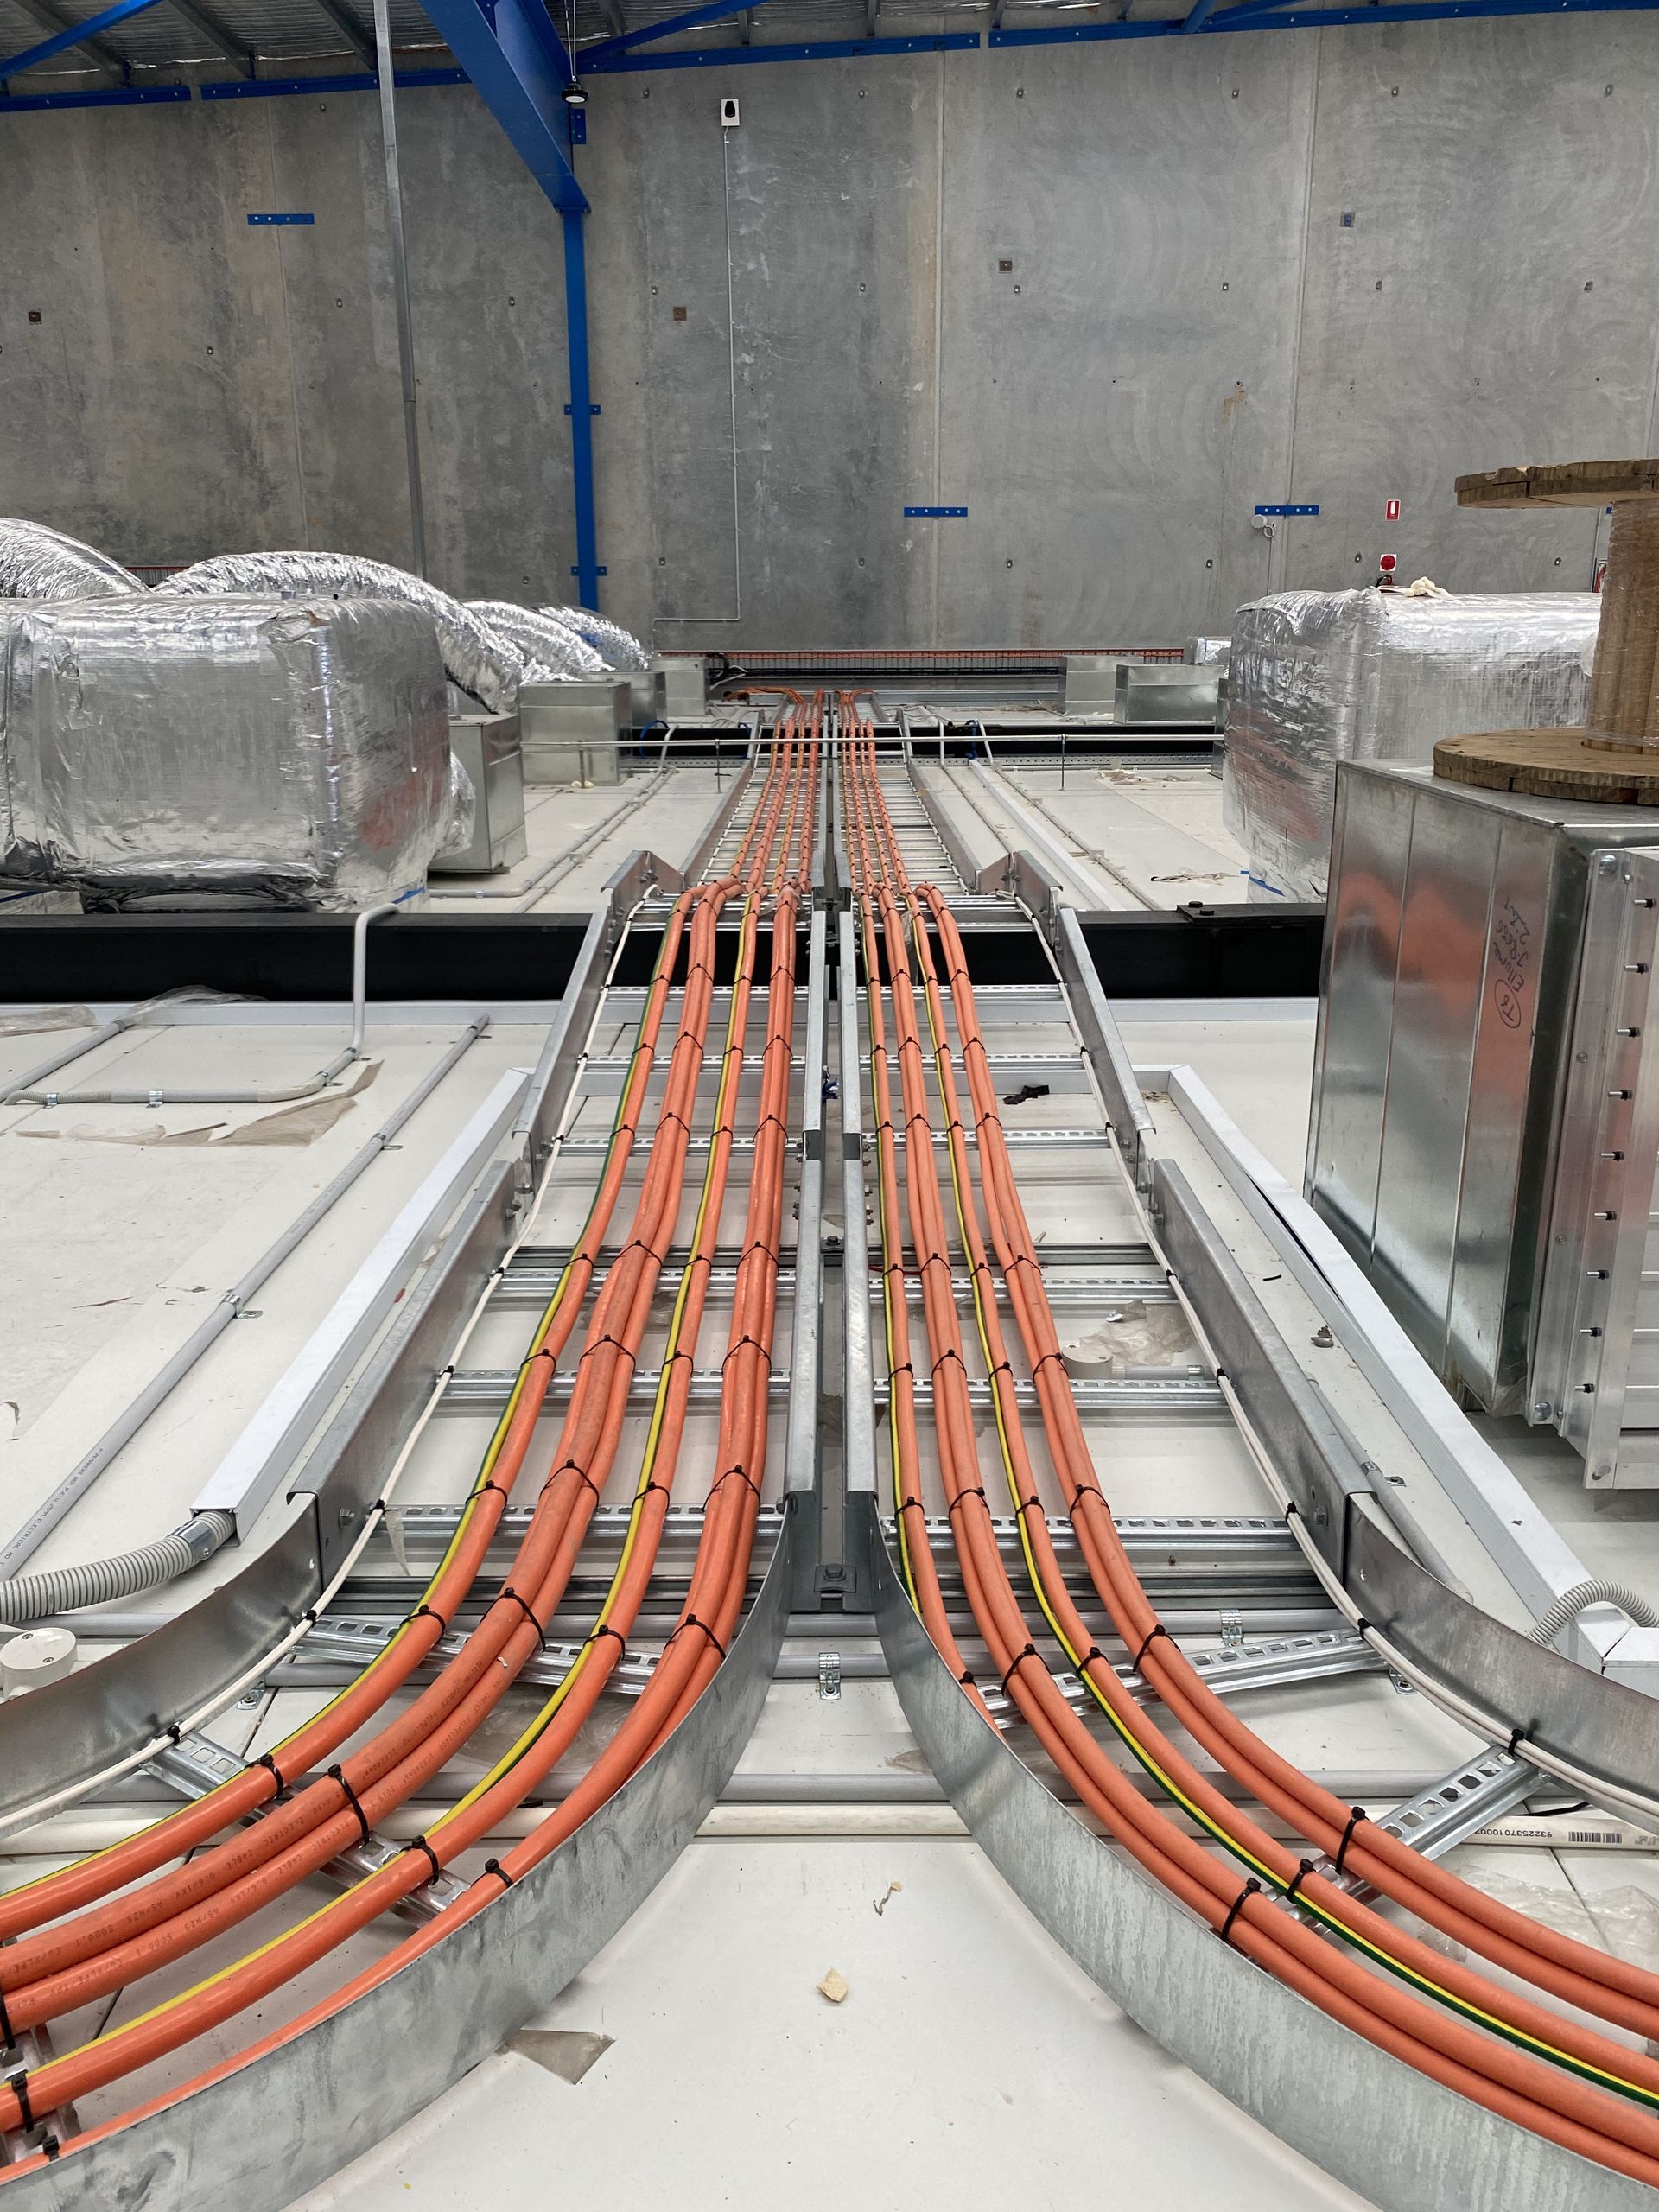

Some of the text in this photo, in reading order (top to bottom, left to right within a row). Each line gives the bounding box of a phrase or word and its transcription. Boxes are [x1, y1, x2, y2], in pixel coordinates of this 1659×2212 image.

[12, 1516, 42, 1549] ELECTRICAL
[261, 1815, 305, 1847] ELECTRIC
[310, 1820, 349, 1851] ELECTRIC
[225, 1847, 253, 1870] CABLE
[275, 1853, 302, 1875] CABLE
